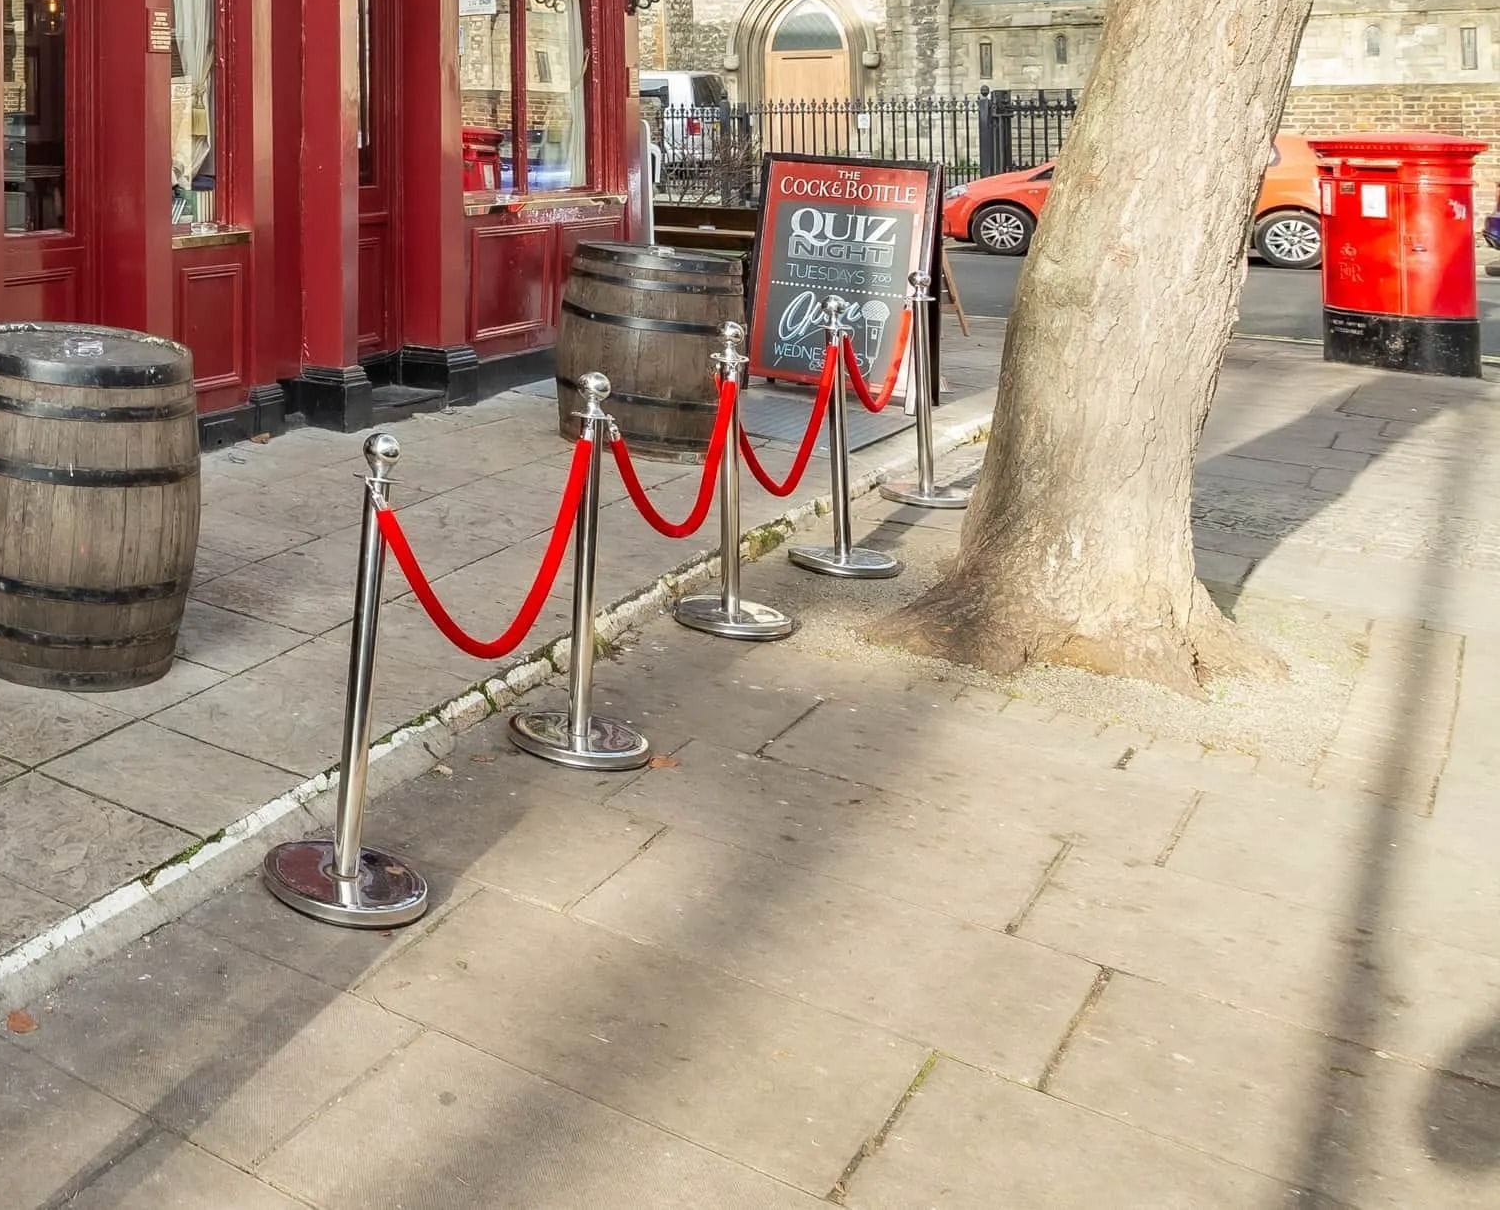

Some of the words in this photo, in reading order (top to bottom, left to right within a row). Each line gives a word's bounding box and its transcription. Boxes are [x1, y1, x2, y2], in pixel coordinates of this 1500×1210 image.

[837, 169, 861, 181] THE
[780, 176, 831, 198] COCK
[845, 180, 918, 205] BOTTLE
[790, 207, 898, 246] QUIZ
[794, 238, 890, 264] NIGHT
[786, 262, 866, 286] TUESDAYS
